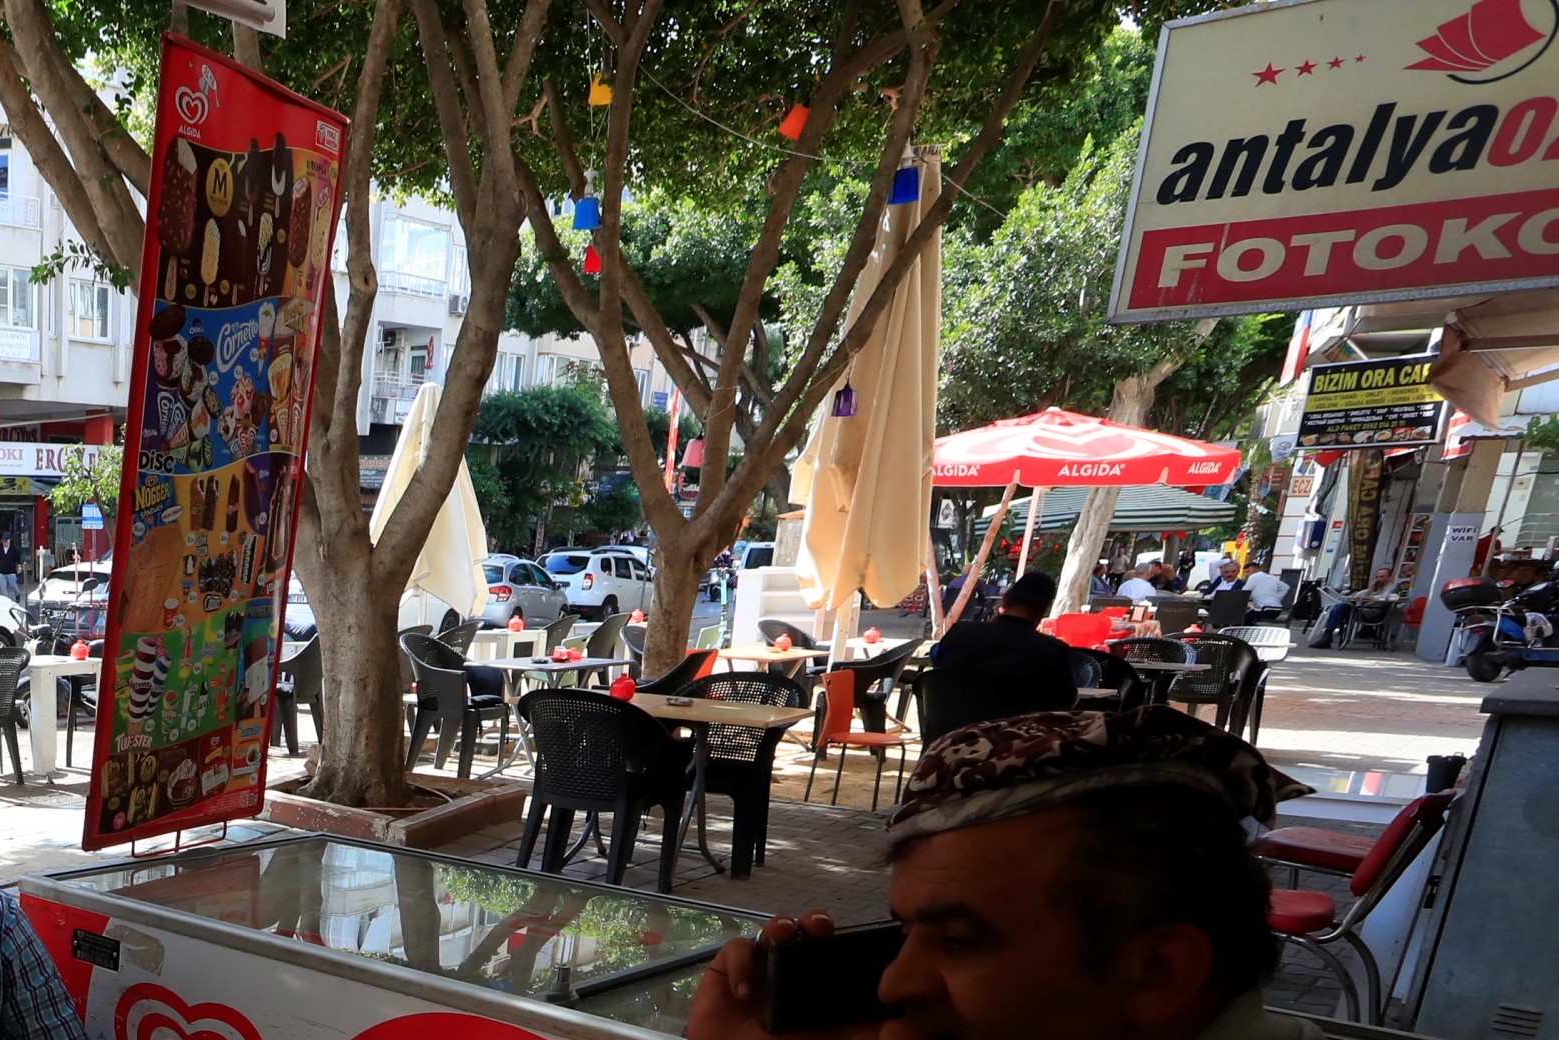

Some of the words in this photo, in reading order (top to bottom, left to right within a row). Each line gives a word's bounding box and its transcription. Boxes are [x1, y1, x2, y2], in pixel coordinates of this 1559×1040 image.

[216, 320, 259, 373] Cornetto
[1313, 368, 1359, 393] BİZİM
[1361, 368, 1394, 388] ORA
[1399, 362, 1432, 385] CAF
[134, 482, 170, 512] NOGGER
